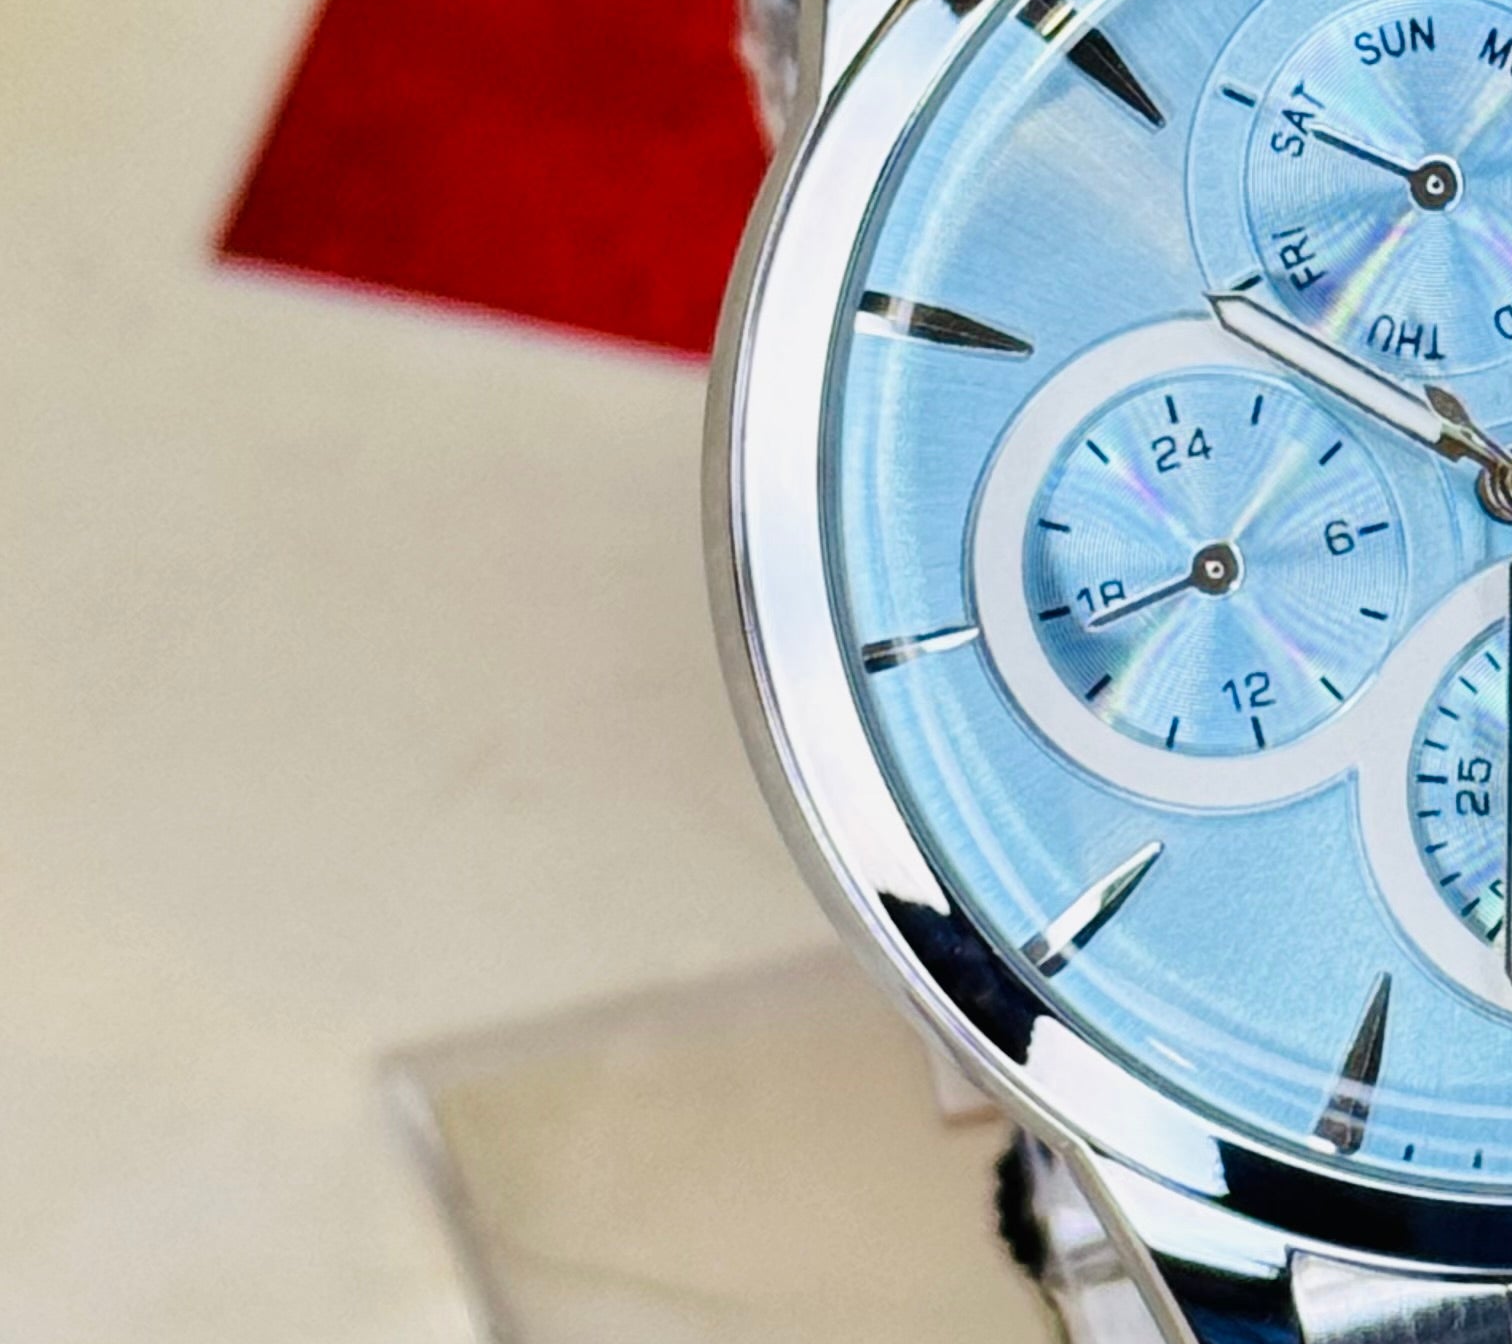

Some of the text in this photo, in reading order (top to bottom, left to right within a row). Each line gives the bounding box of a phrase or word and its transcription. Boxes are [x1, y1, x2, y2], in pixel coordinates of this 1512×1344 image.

[1353, 16, 1437, 66] SUN
[1271, 82, 1326, 159] SAT
[1273, 227, 1328, 291] FRI
[1366, 314, 1447, 361] THU
[1151, 427, 1213, 474] 24
[1323, 520, 1355, 556] 6
[1221, 671, 1276, 712] 12
[1455, 756, 1492, 818] 25
